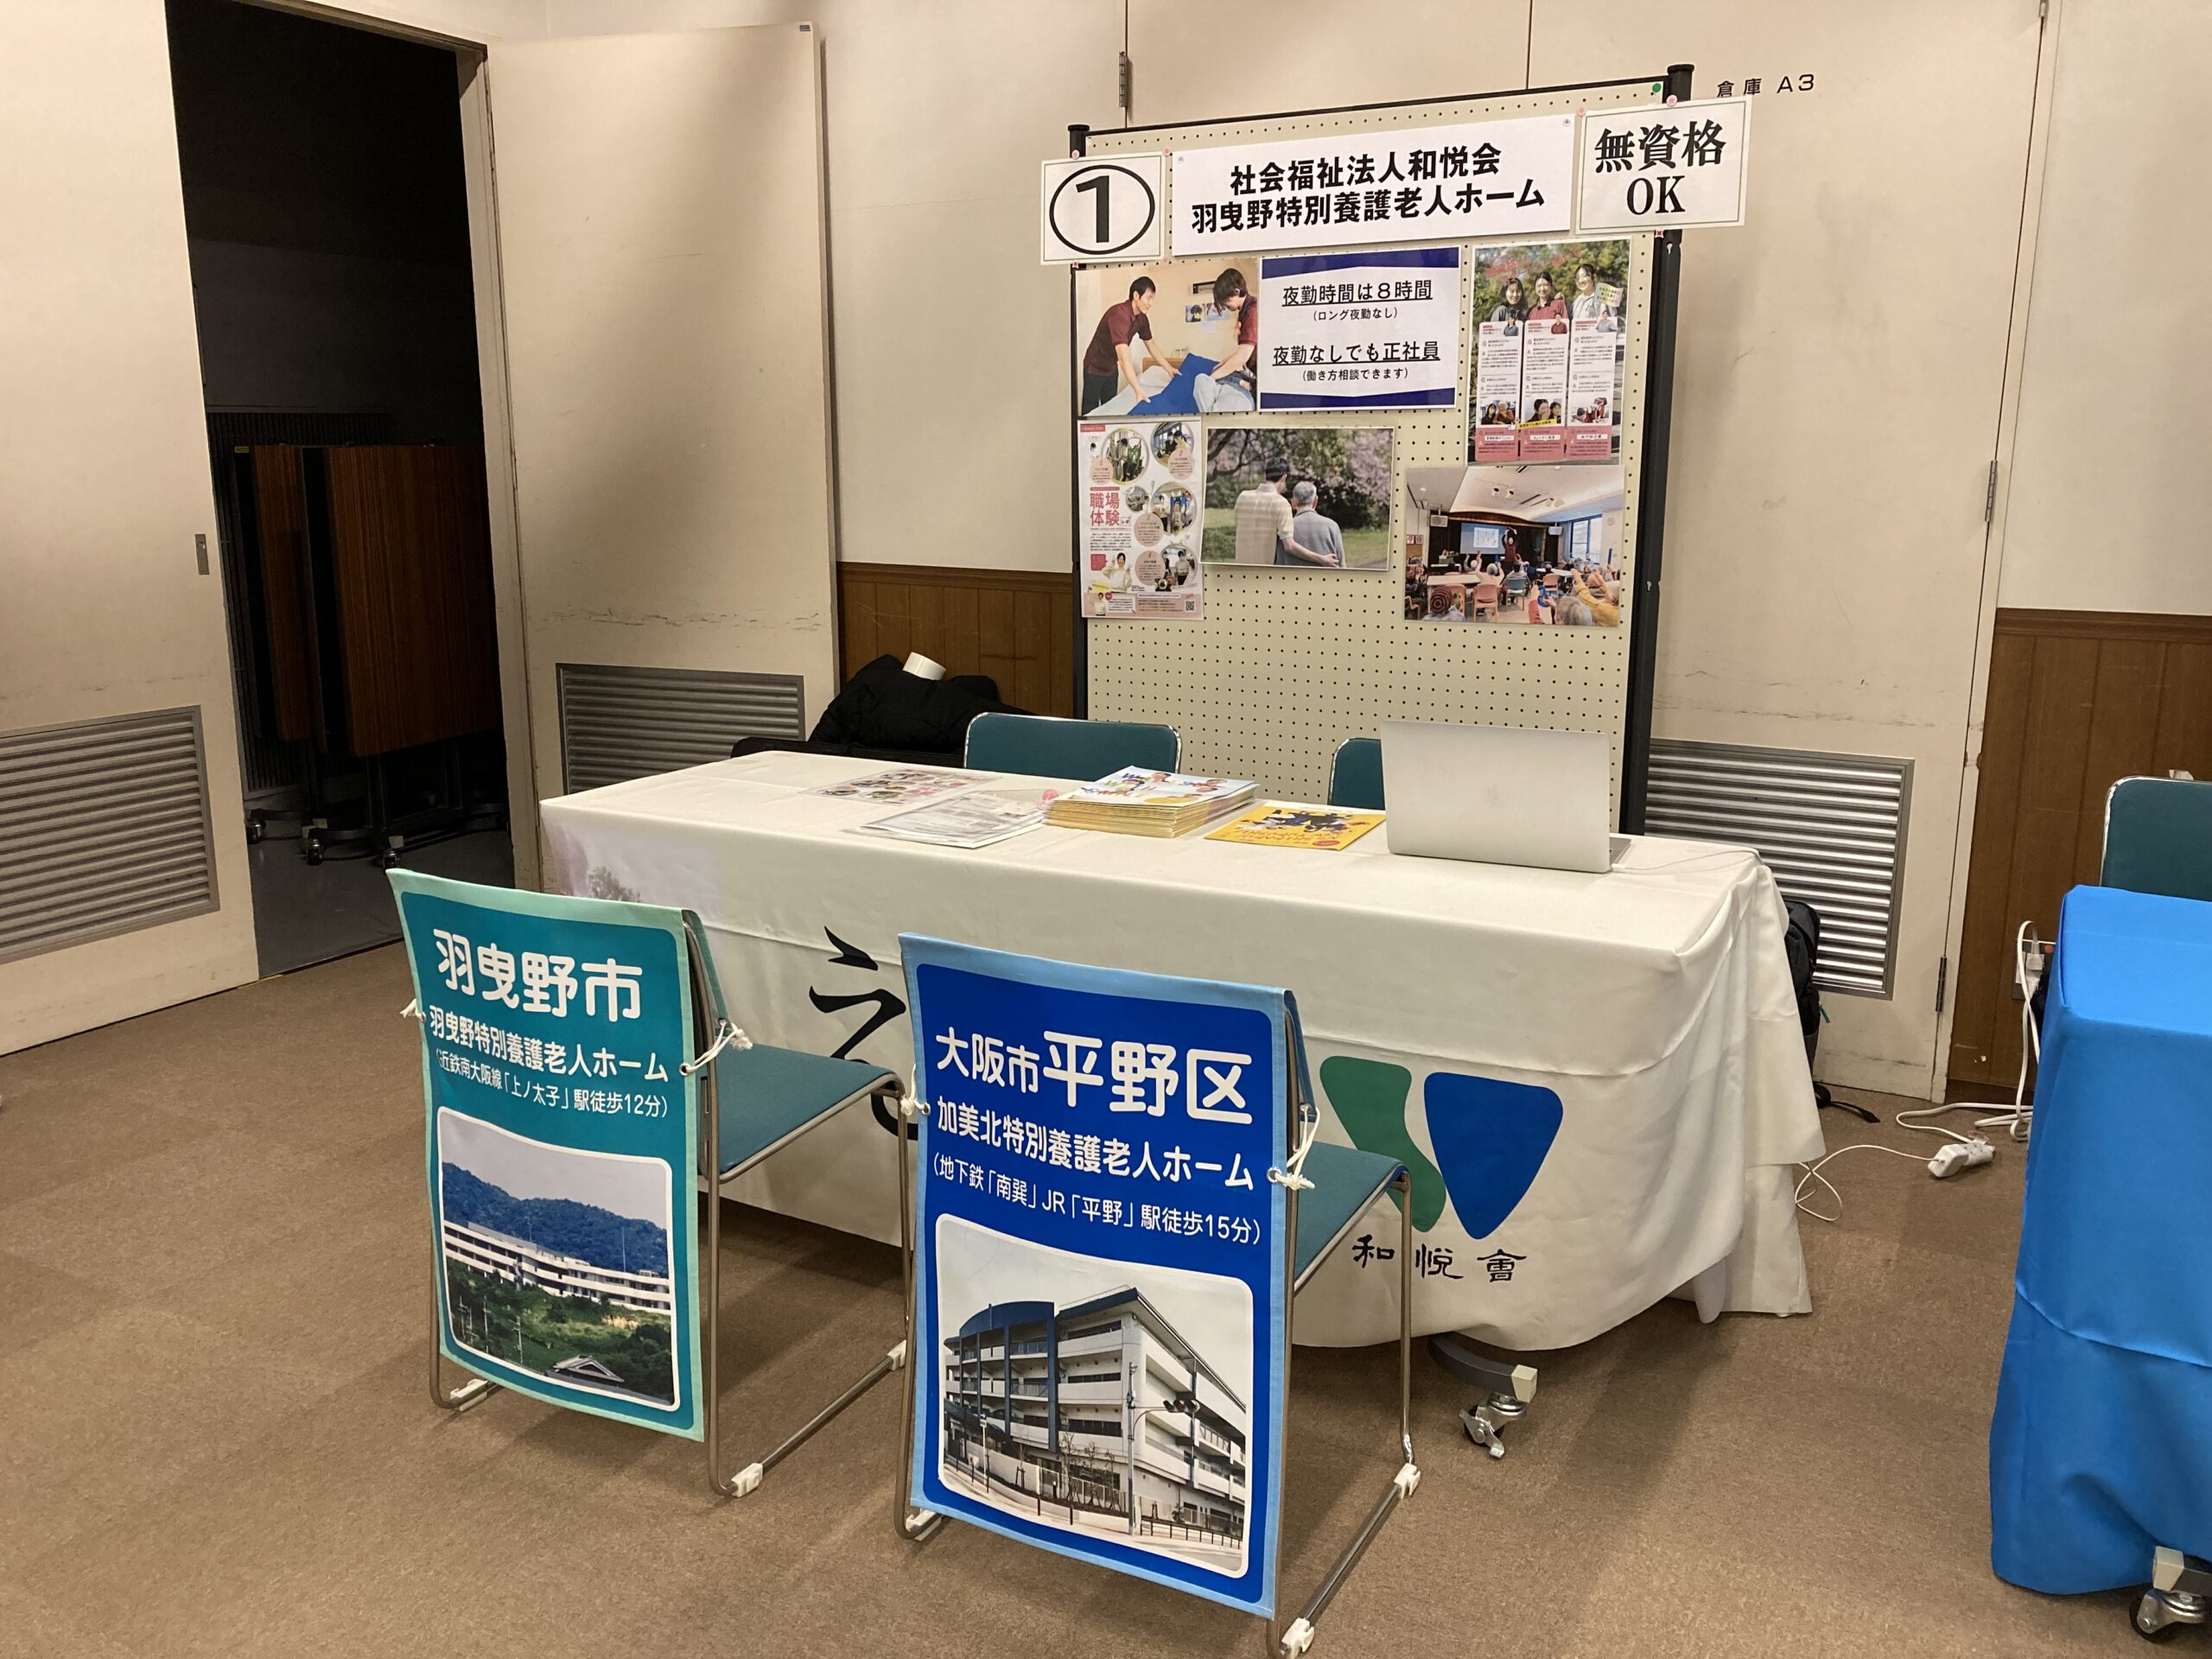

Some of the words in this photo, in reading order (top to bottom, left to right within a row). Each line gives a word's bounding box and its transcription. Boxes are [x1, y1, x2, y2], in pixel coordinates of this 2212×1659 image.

[1716, 78, 1763, 98] 倉庫
[1777, 73, 1815, 94] A3
[1230, 142, 1502, 196] 社会福祉法人和悦会
[1593, 118, 1727, 174] 無資格
[1191, 177, 1545, 234] 羽曳野特別養護老人ホーム
[1626, 175, 1687, 216] OK
[1272, 340, 1441, 365] 夜勤なしでも正社員
[1090, 493, 1121, 509] 職場
[1090, 510, 1121, 526] 体験
[432, 927, 644, 1023] 羽曳野市
[429, 1004, 670, 1083] 羽曳野特別養護老人ホーム
[935, 1026, 1253, 1125] 大阪市平野区
[937, 1095, 1255, 1191] 加美北特別養護老人ホーム
